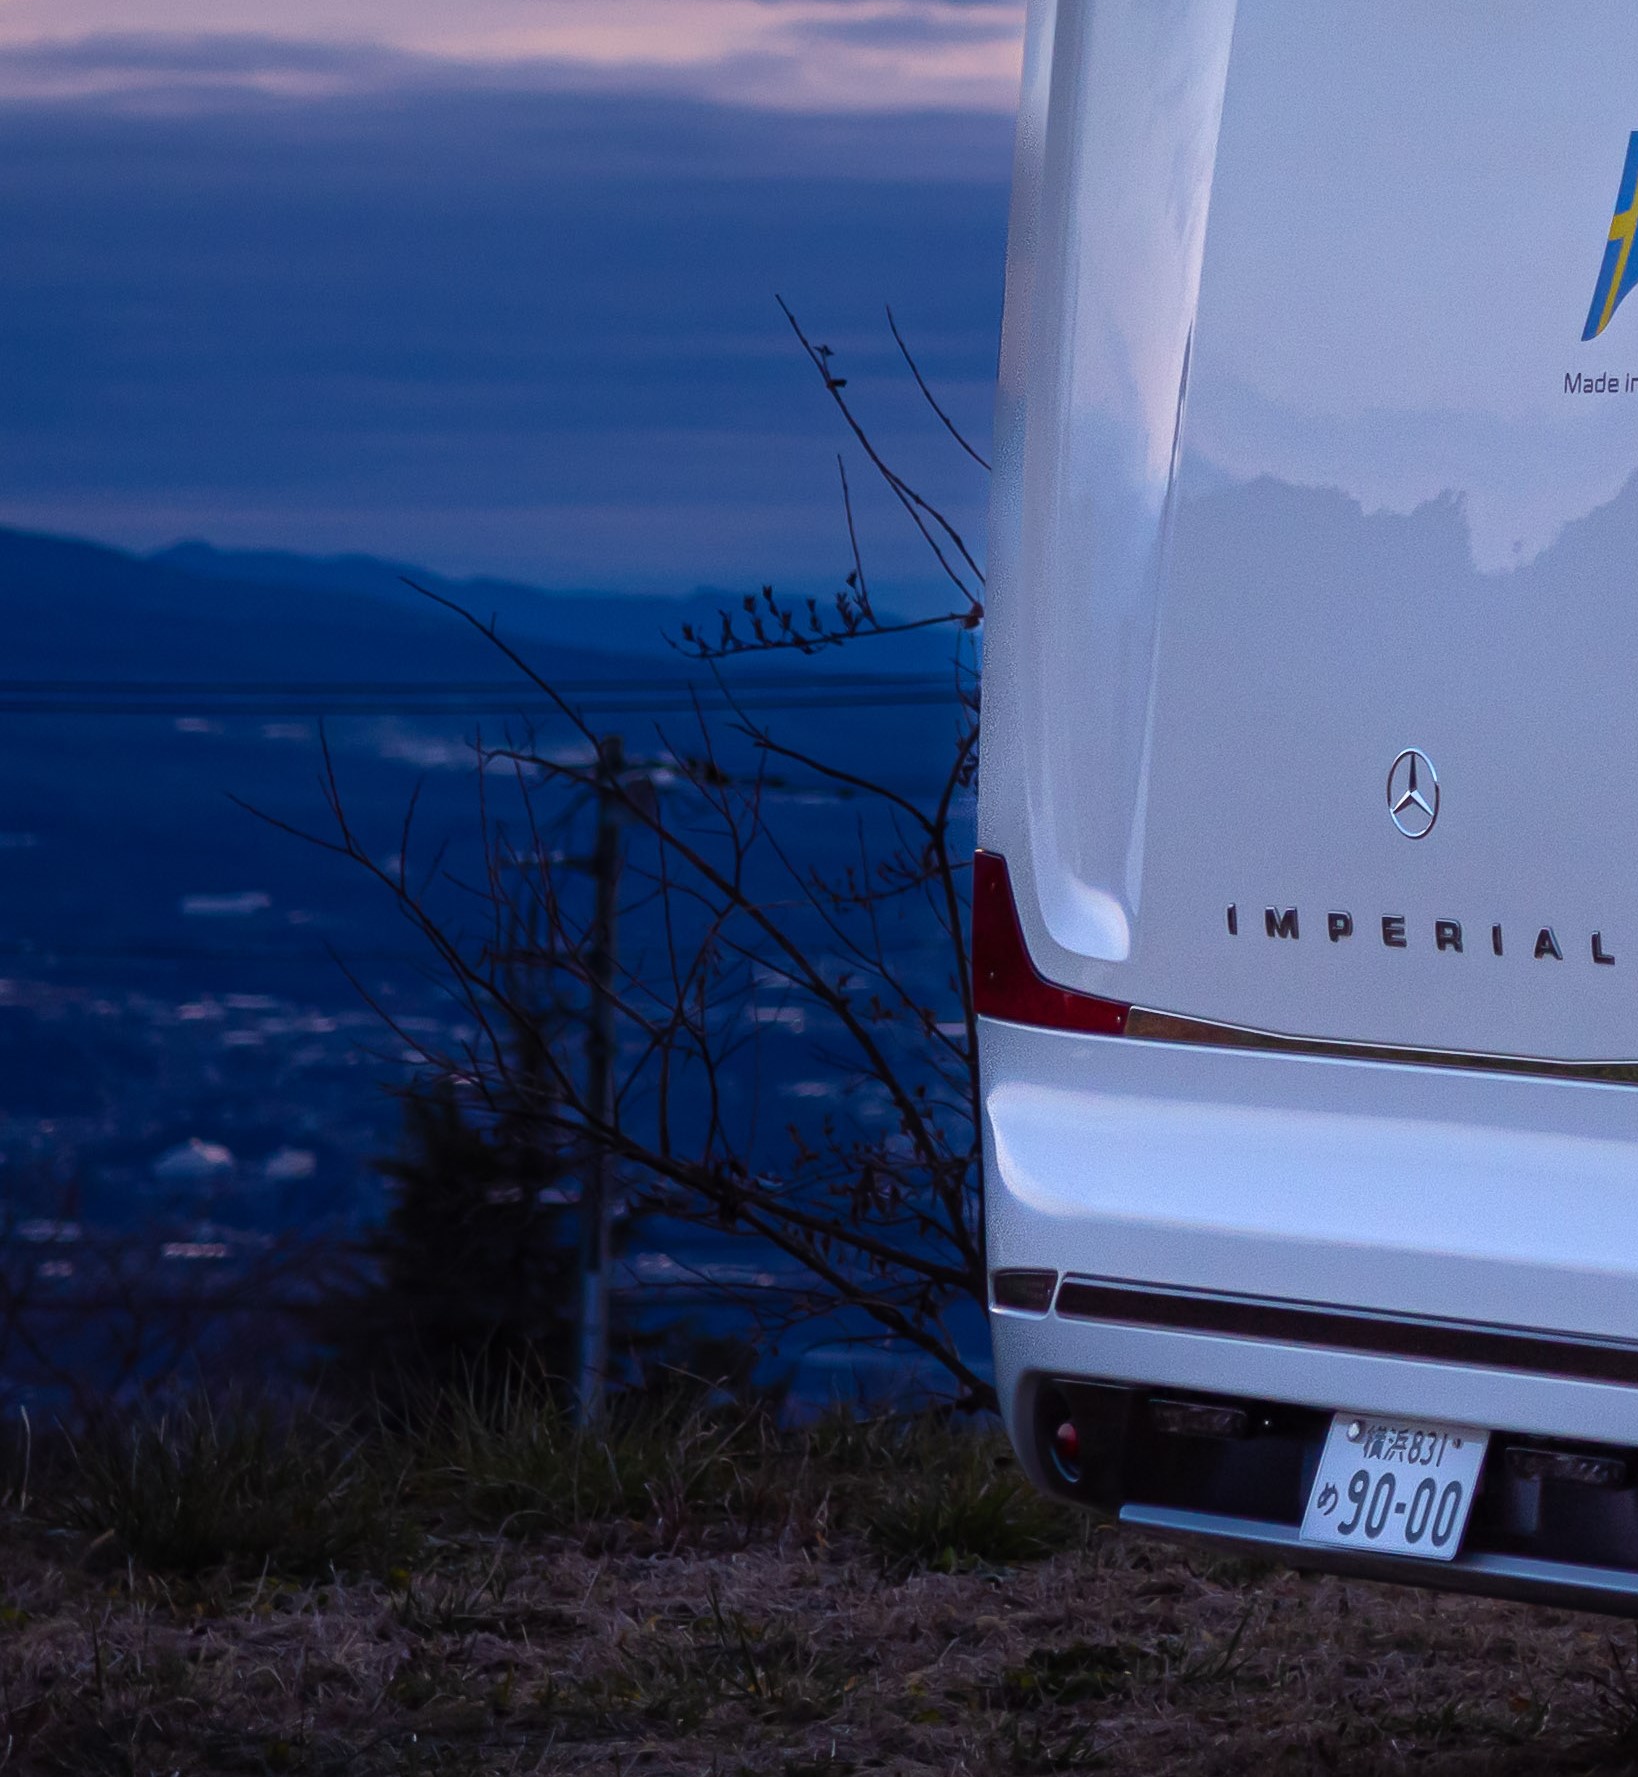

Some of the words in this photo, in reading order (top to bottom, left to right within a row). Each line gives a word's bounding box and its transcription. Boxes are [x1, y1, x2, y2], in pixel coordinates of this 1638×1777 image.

[1564, 372, 1620, 394] Made
[1226, 902, 1616, 966] IMPERIAL
[1317, 1481, 1339, 1516] め
[1337, 1469, 1463, 1547] 90-00
